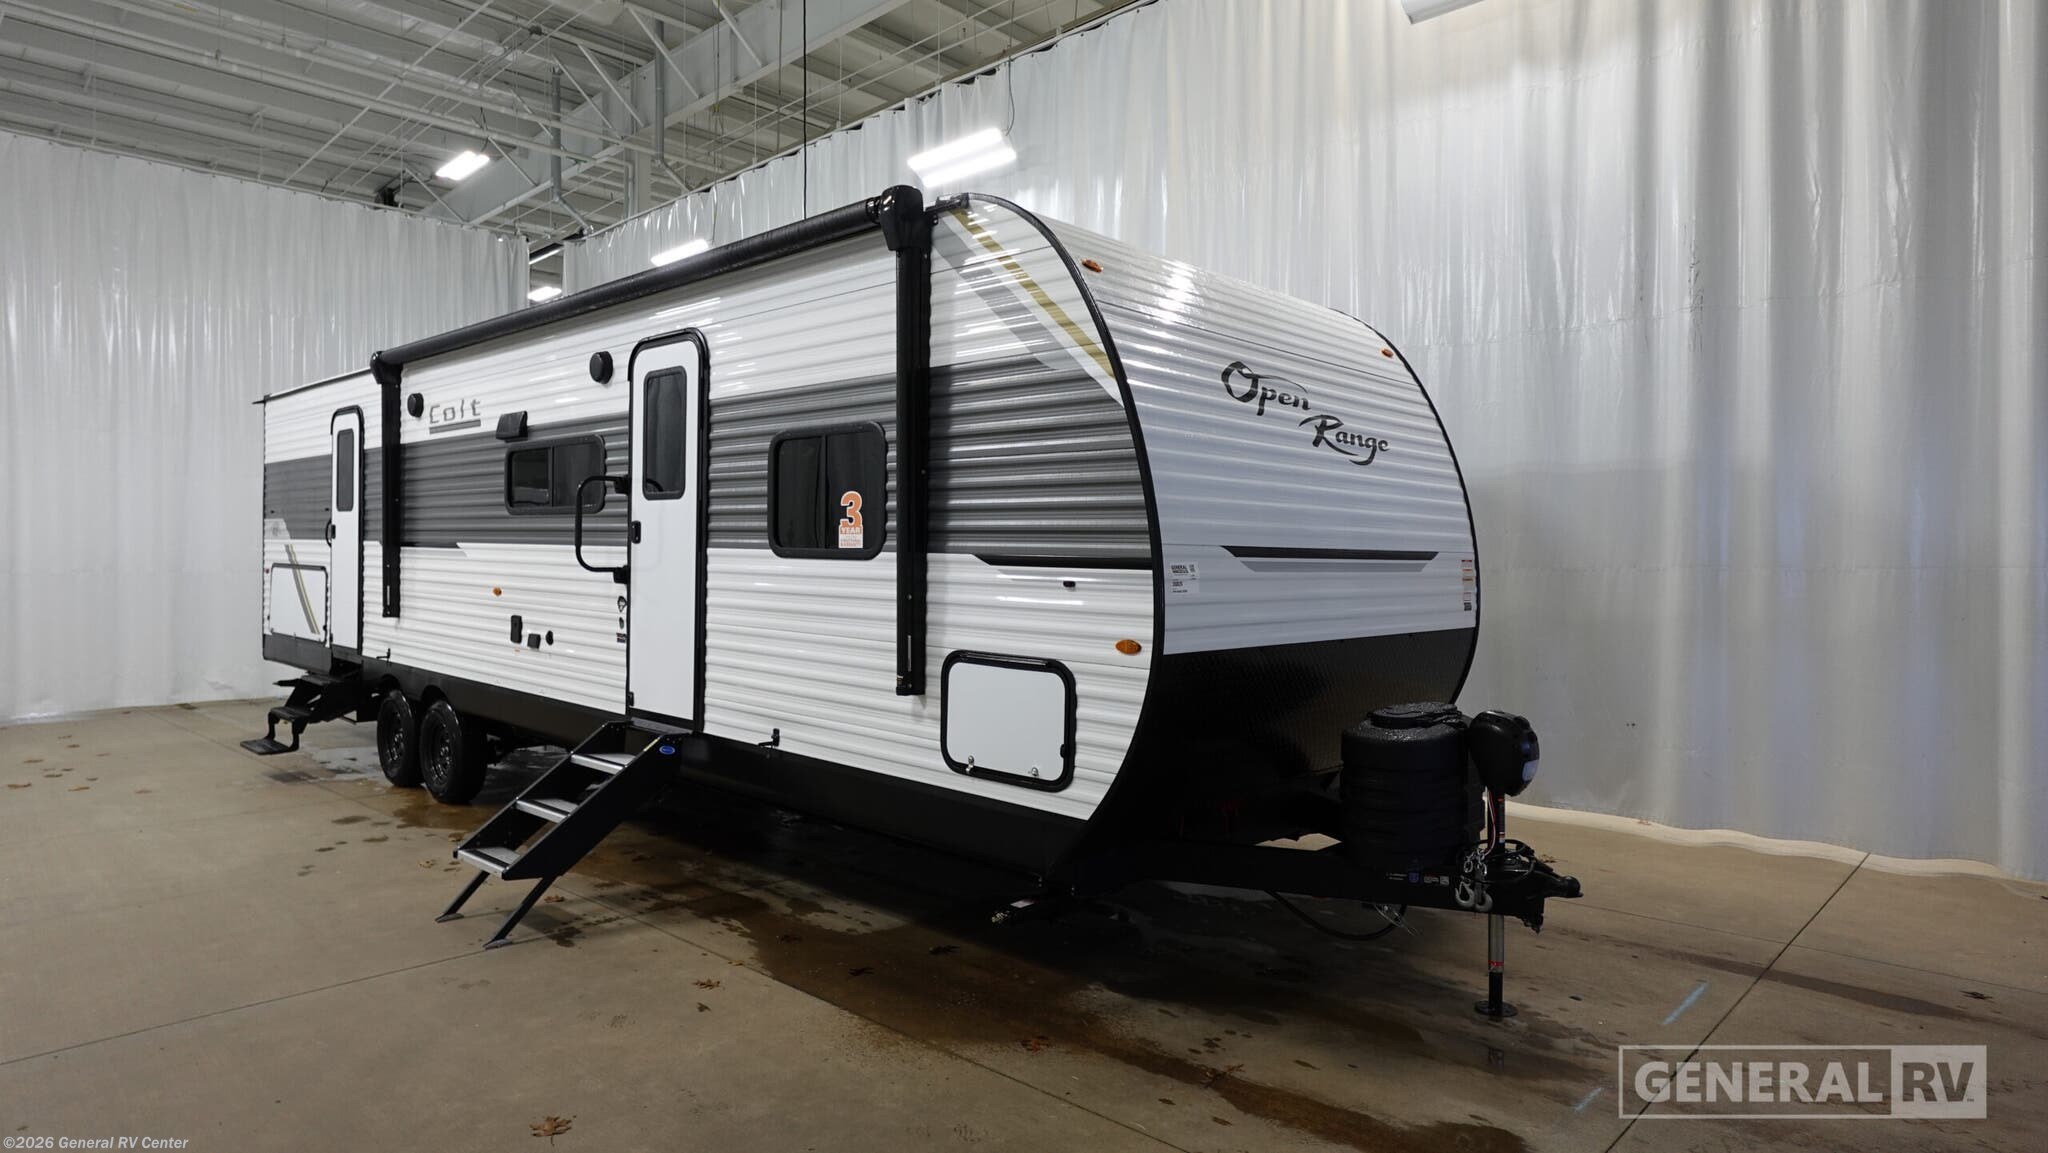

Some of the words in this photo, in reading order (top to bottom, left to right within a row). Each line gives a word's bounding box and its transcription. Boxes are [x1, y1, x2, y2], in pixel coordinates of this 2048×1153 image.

[1221, 361, 1311, 416] Open
[429, 398, 481, 424] Colt
[1299, 414, 1391, 466] Range
[840, 491, 863, 528] 3
